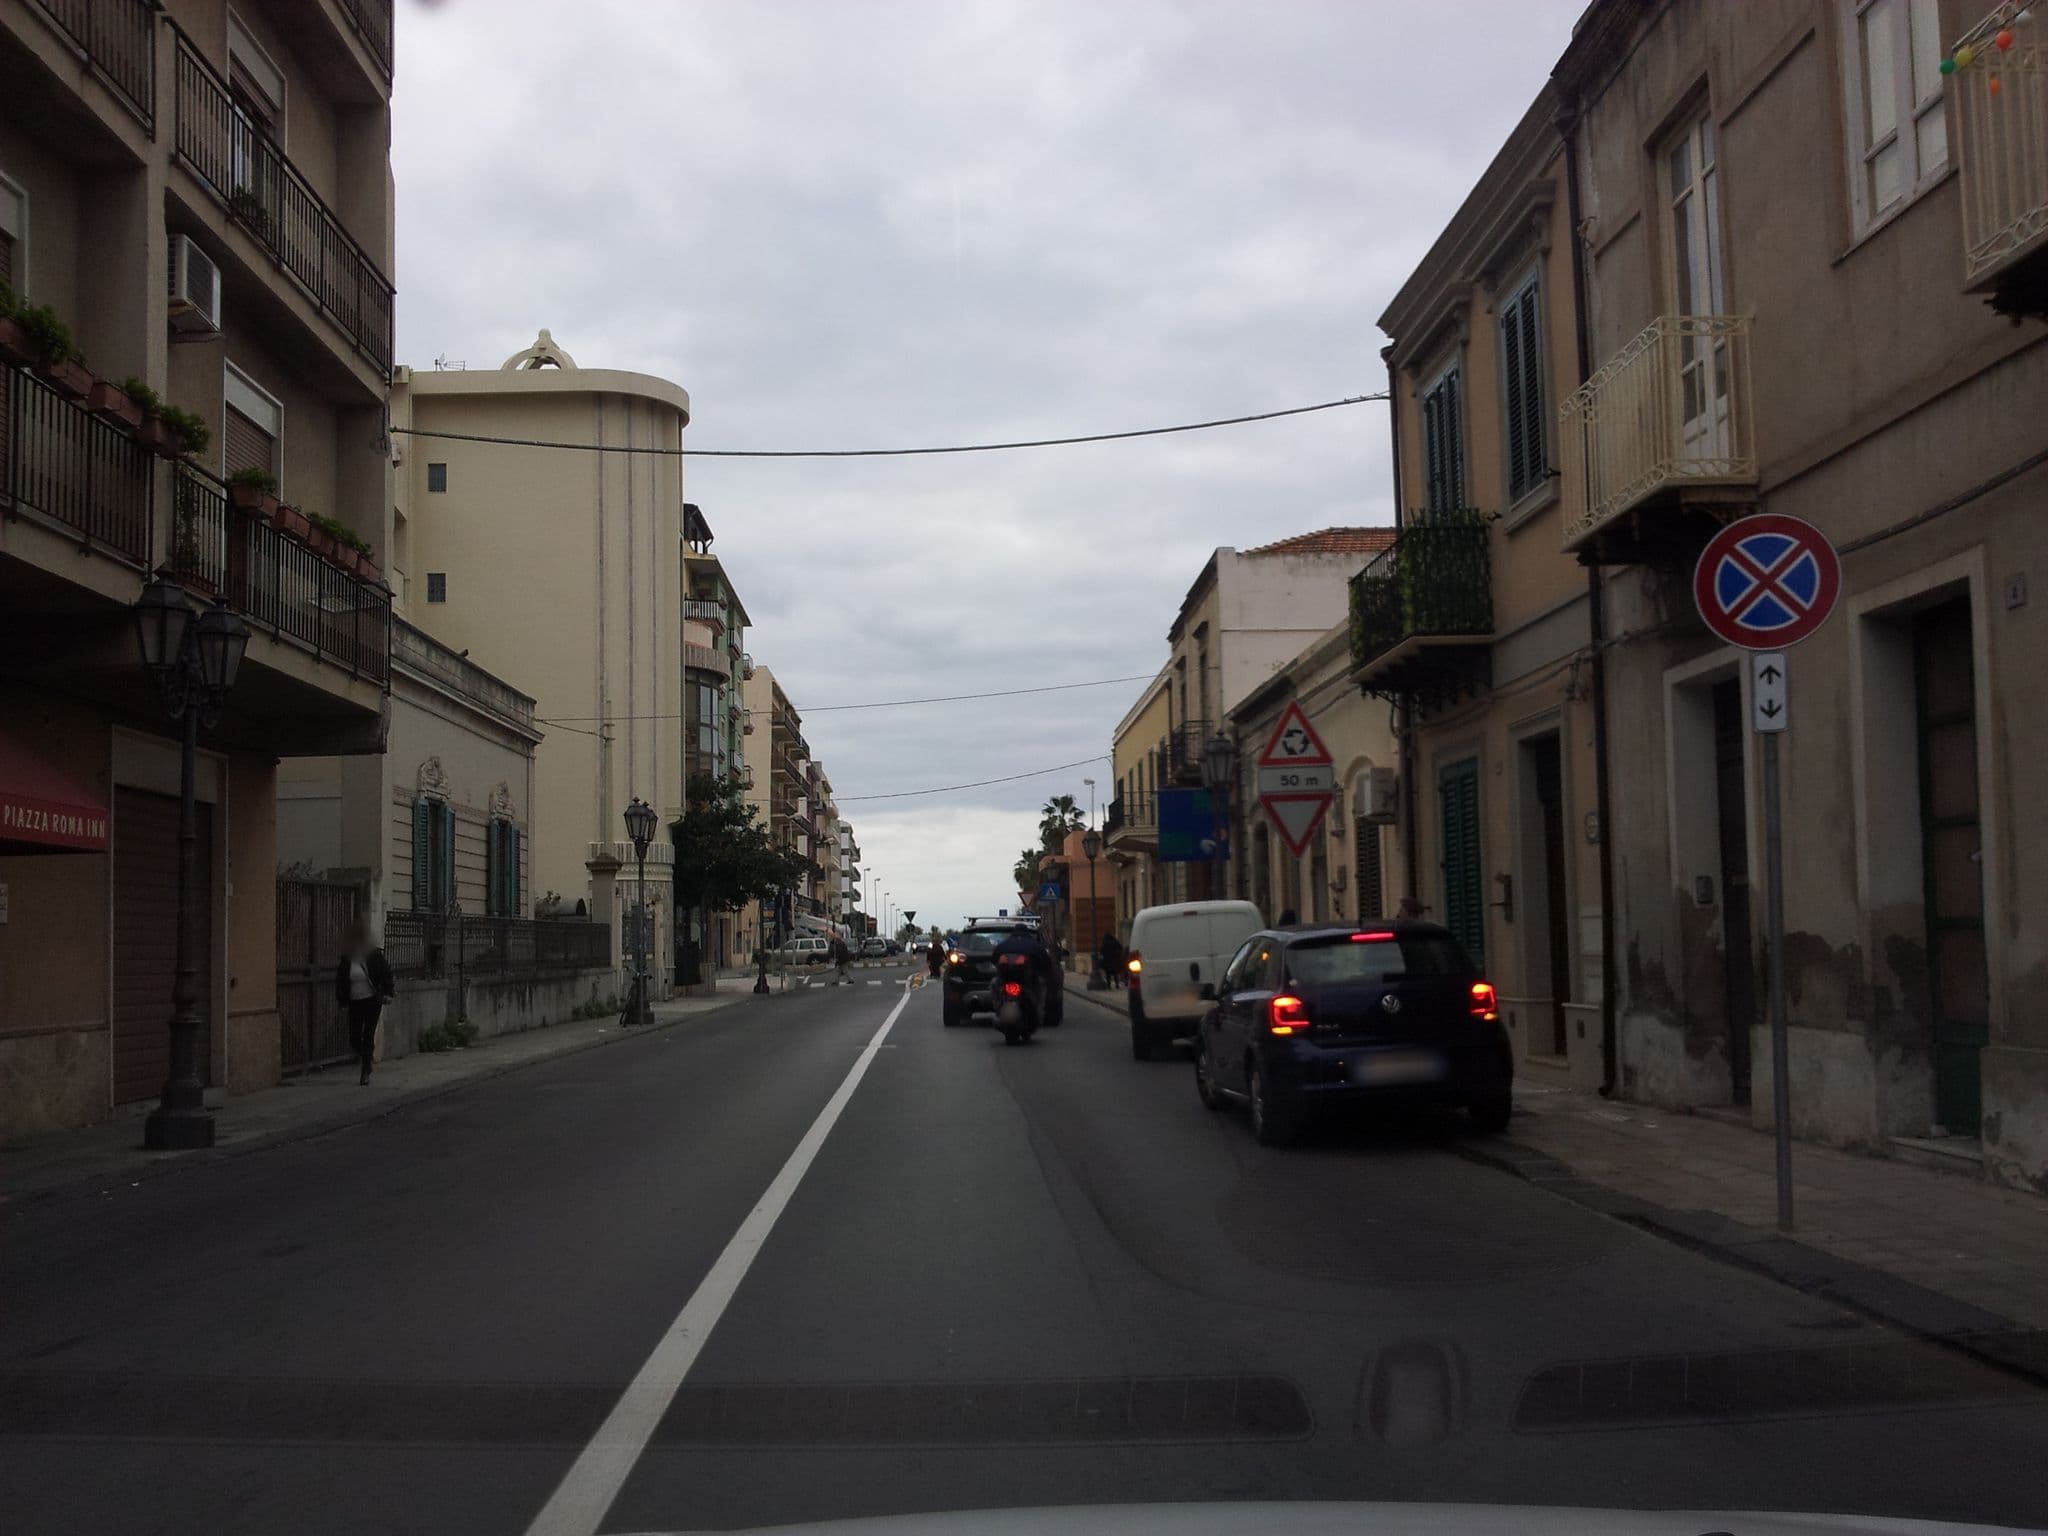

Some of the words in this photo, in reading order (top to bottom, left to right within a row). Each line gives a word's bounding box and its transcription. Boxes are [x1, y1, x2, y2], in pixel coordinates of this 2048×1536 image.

[1280, 775, 1299, 786] 50
[1305, 776, 1318, 785] m
[4, 804, 48, 832] PIAZZA
[52, 813, 84, 837] ROMA
[87, 818, 105, 839] INN
